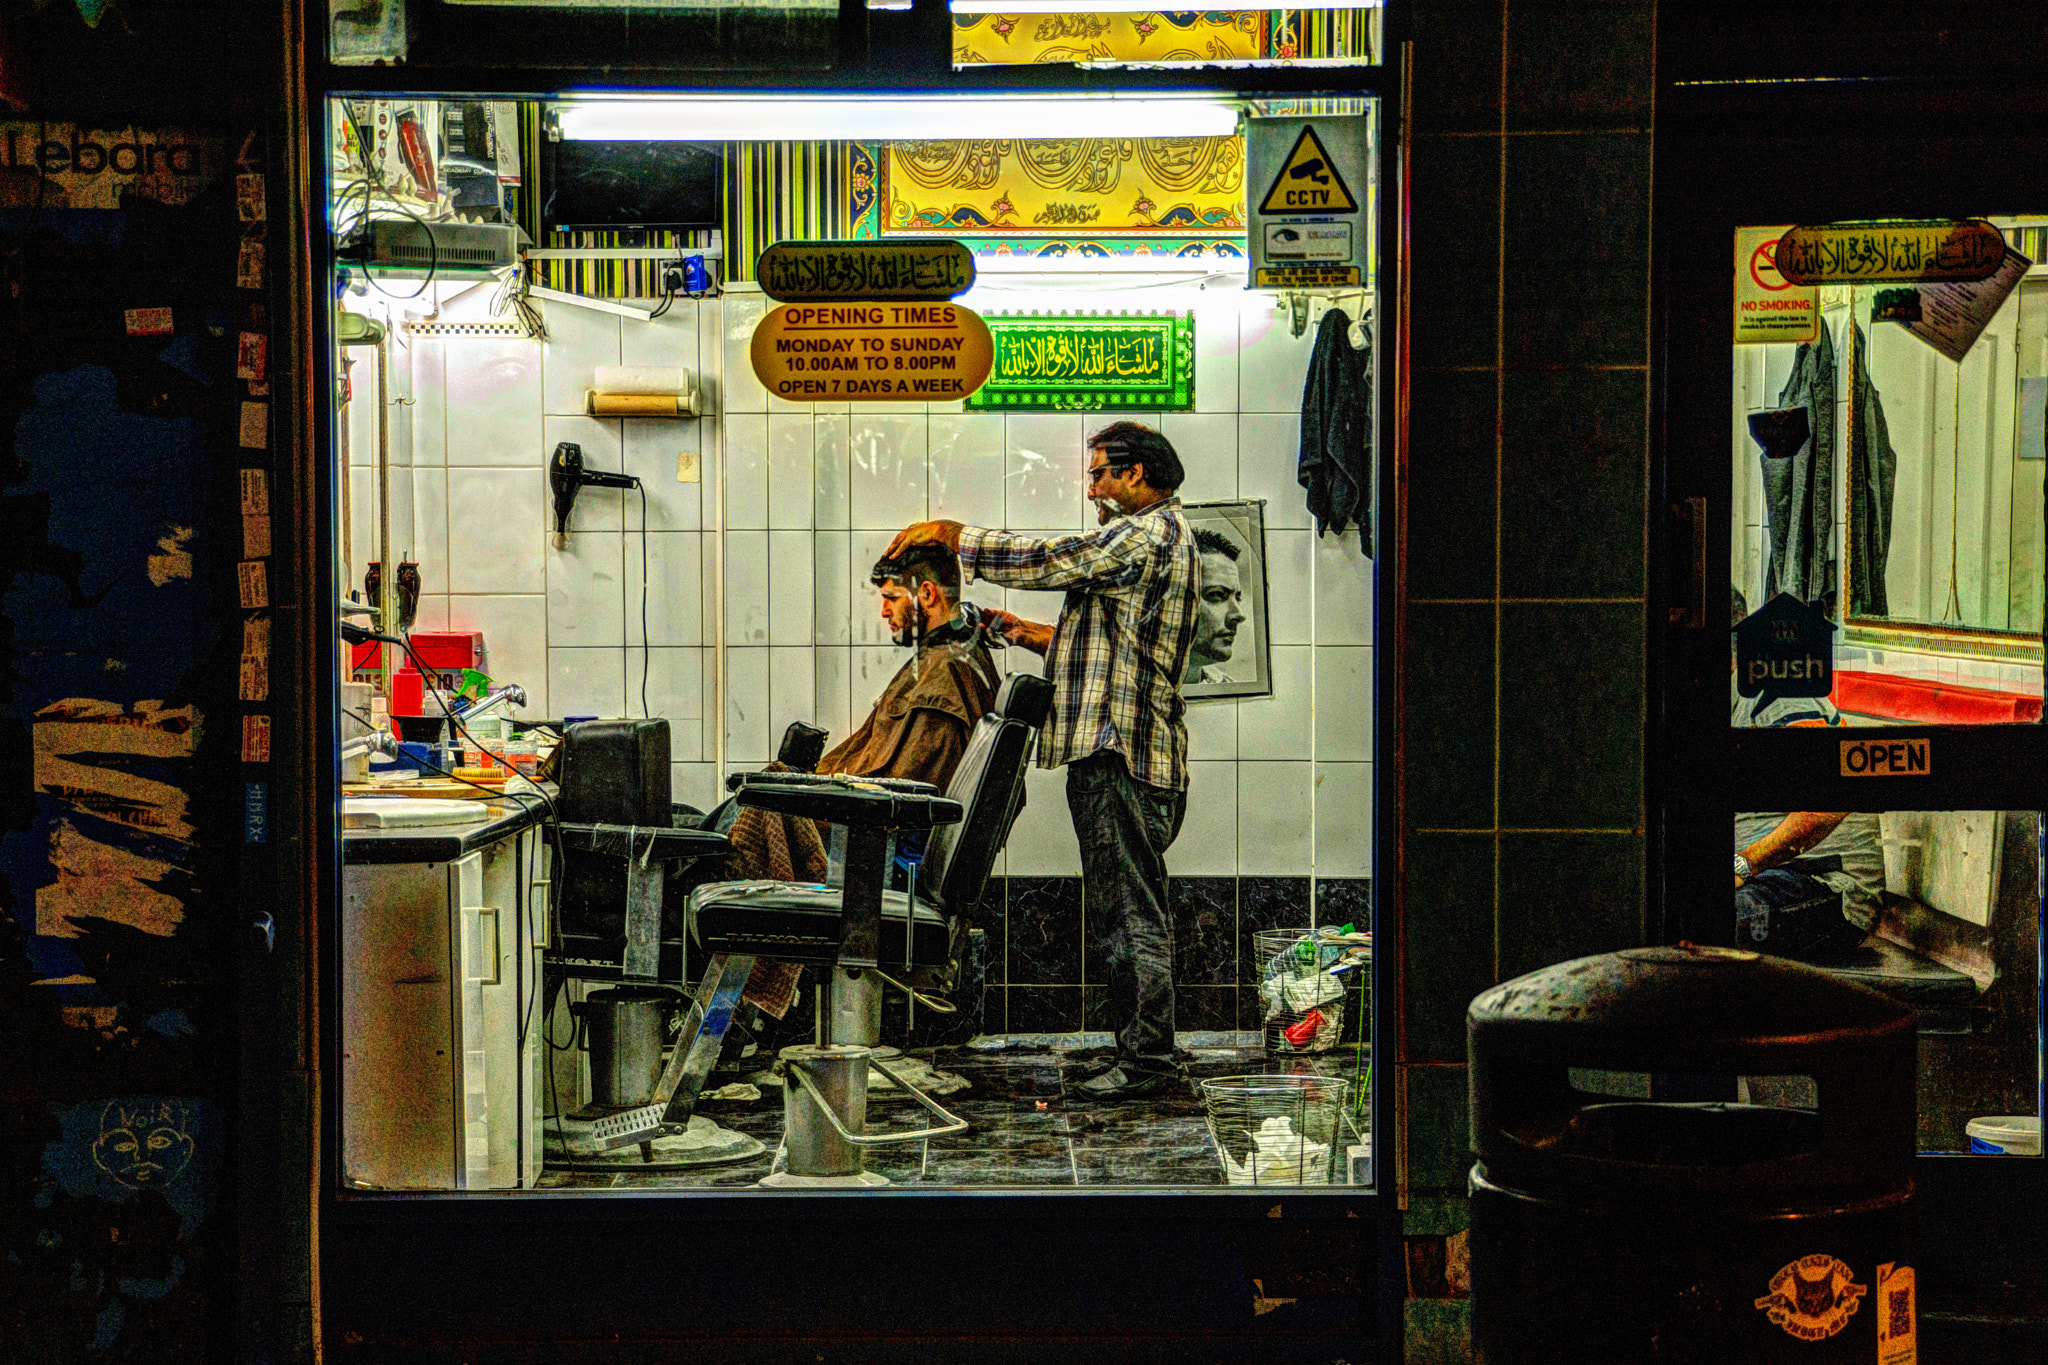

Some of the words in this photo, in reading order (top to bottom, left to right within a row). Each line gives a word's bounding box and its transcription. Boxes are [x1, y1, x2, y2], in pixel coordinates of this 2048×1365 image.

[1286, 189, 1331, 206] CCTV
[1741, 301, 1757, 311] NO
[1759, 299, 1813, 311] SMOKING.
[785, 308, 884, 325] OPENING
[891, 307, 956, 323] TIMES
[776, 339, 855, 352] MONDAY
[860, 338, 885, 351] TO
[890, 337, 965, 351] SUNDAY
[786, 357, 859, 371] 10.00AM
[864, 357, 888, 370] TO
[894, 356, 956, 370] 8.00PM
[778, 380, 827, 393] OPEN
[832, 380, 841, 393] 7
[846, 380, 892, 393] DAYS
[897, 379, 909, 392] A
[912, 379, 964, 392] WEEK
[1749, 653, 1824, 684] push
[1846, 744, 1926, 773] OPEN
